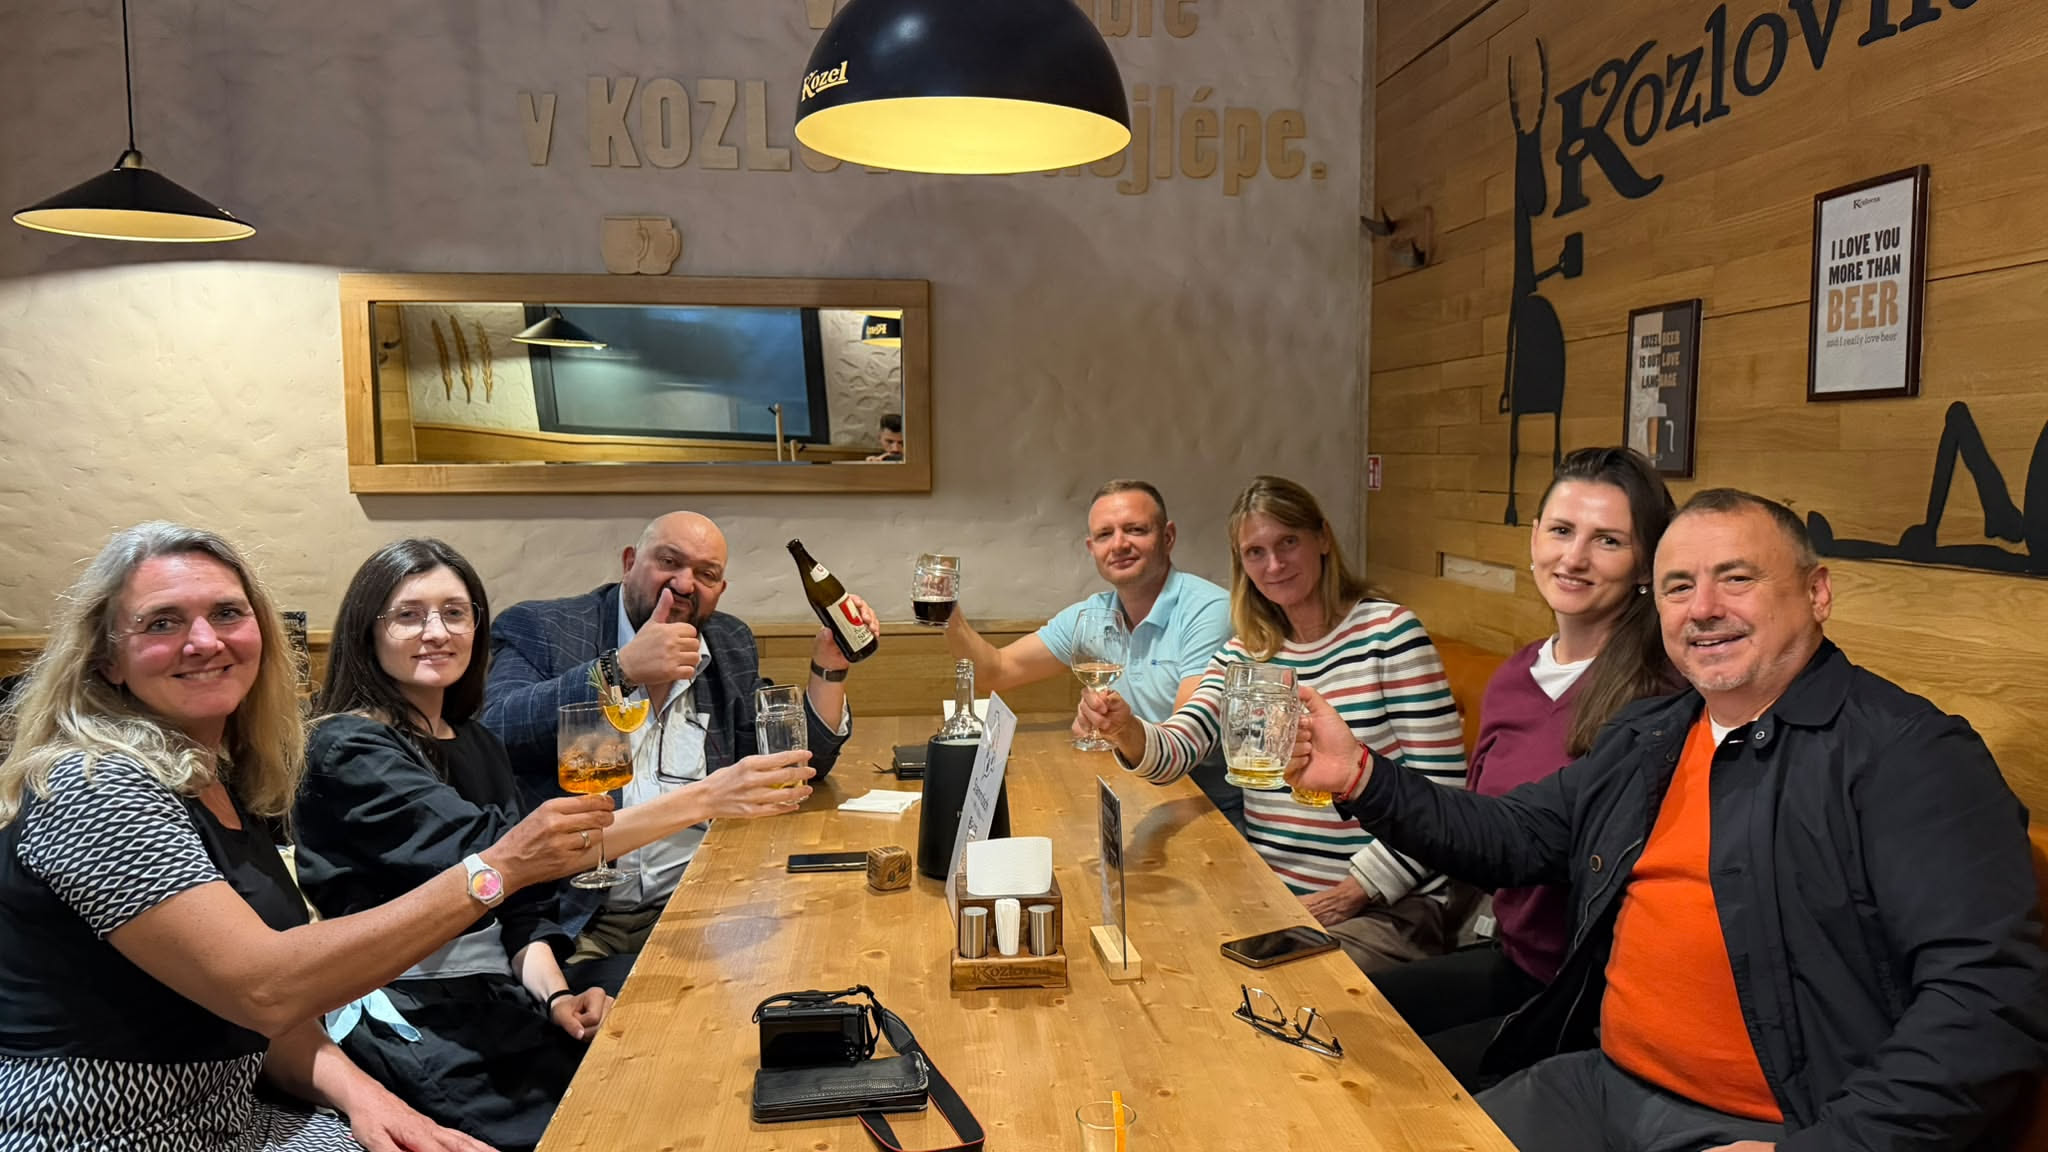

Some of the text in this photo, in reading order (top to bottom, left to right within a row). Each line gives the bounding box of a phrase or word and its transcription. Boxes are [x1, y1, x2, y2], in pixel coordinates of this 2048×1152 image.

[801, 60, 849, 103] Kozel
[1553, 0, 1979, 218] Kozlov
[586, 75, 888, 173] KOZL
[1041, 84, 1328, 197] jlépe.
[1831, 226, 1901, 261] I LOVE YOU
[1828, 253, 1901, 286] MORE THAN
[1827, 280, 1899, 333] BEER
[1639, 355, 1646, 369] IS
